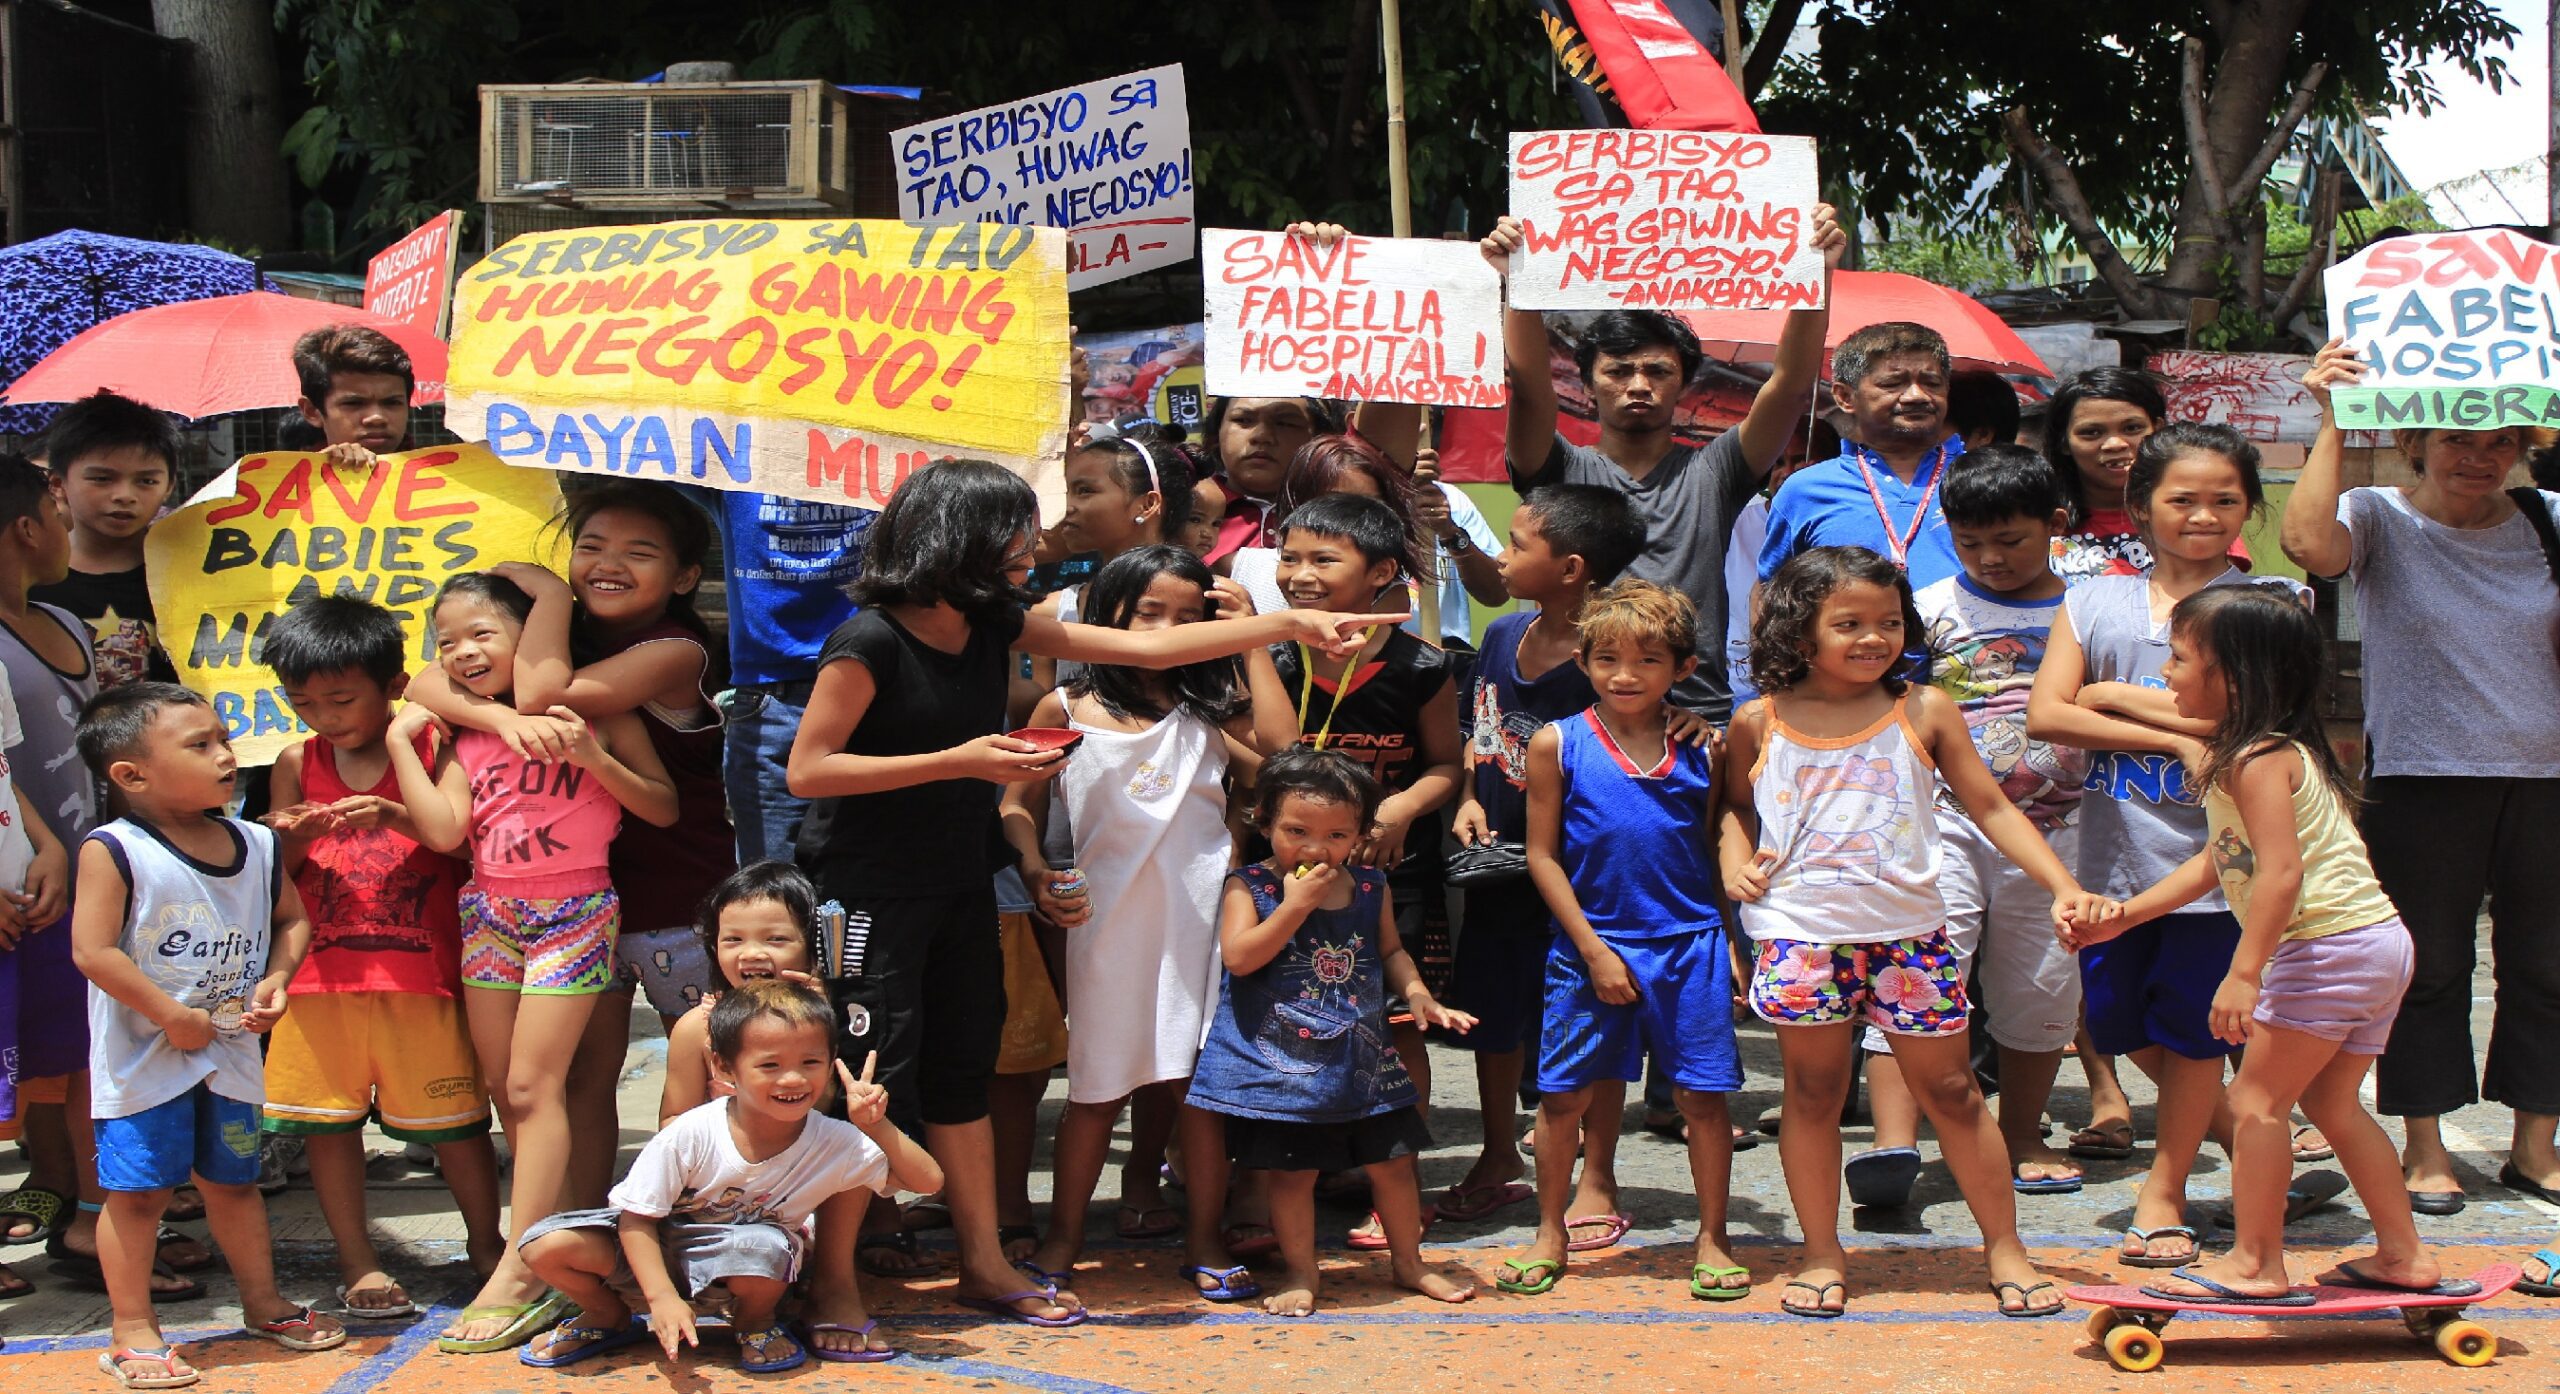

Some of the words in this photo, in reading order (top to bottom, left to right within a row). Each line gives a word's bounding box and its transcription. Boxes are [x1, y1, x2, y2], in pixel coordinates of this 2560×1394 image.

[903, 92, 1087, 177] SERBISYO
[1516, 132, 1772, 180] SERBISYO
[905, 163, 1007, 219] TAO,
[1016, 121, 1148, 189] HUWAG
[1046, 148, 1192, 229] NEGOSYO!
[1553, 171, 1634, 212] SA
[475, 222, 779, 281] SERBISYO
[803, 223, 868, 259] SA
[903, 220, 1036, 271] TAO
[1522, 211, 1620, 254] WAG
[1625, 202, 1800, 246] GAWING
[371, 226, 444, 292] PRESIDENT
[1222, 235, 1373, 286] SAVE
[1559, 243, 1799, 290] NEGOSYO!
[476, 269, 724, 322] HUWAG
[751, 262, 1016, 345] GAWING
[1237, 286, 1446, 338] FABELLA
[2343, 283, 2560, 344] FABEL
[493, 316, 983, 412] NEGOSYO!
[1240, 330, 1486, 382] HOSPITAL!
[2355, 339, 2560, 381] HOSPI
[486, 402, 752, 483] BAYAN
[806, 428, 955, 506] MU
[206, 451, 479, 525] SAVE
[202, 521, 478, 574] BABIES
[1300, 733, 1405, 748] ATANG
[158, 929, 262, 965] Garfiel
